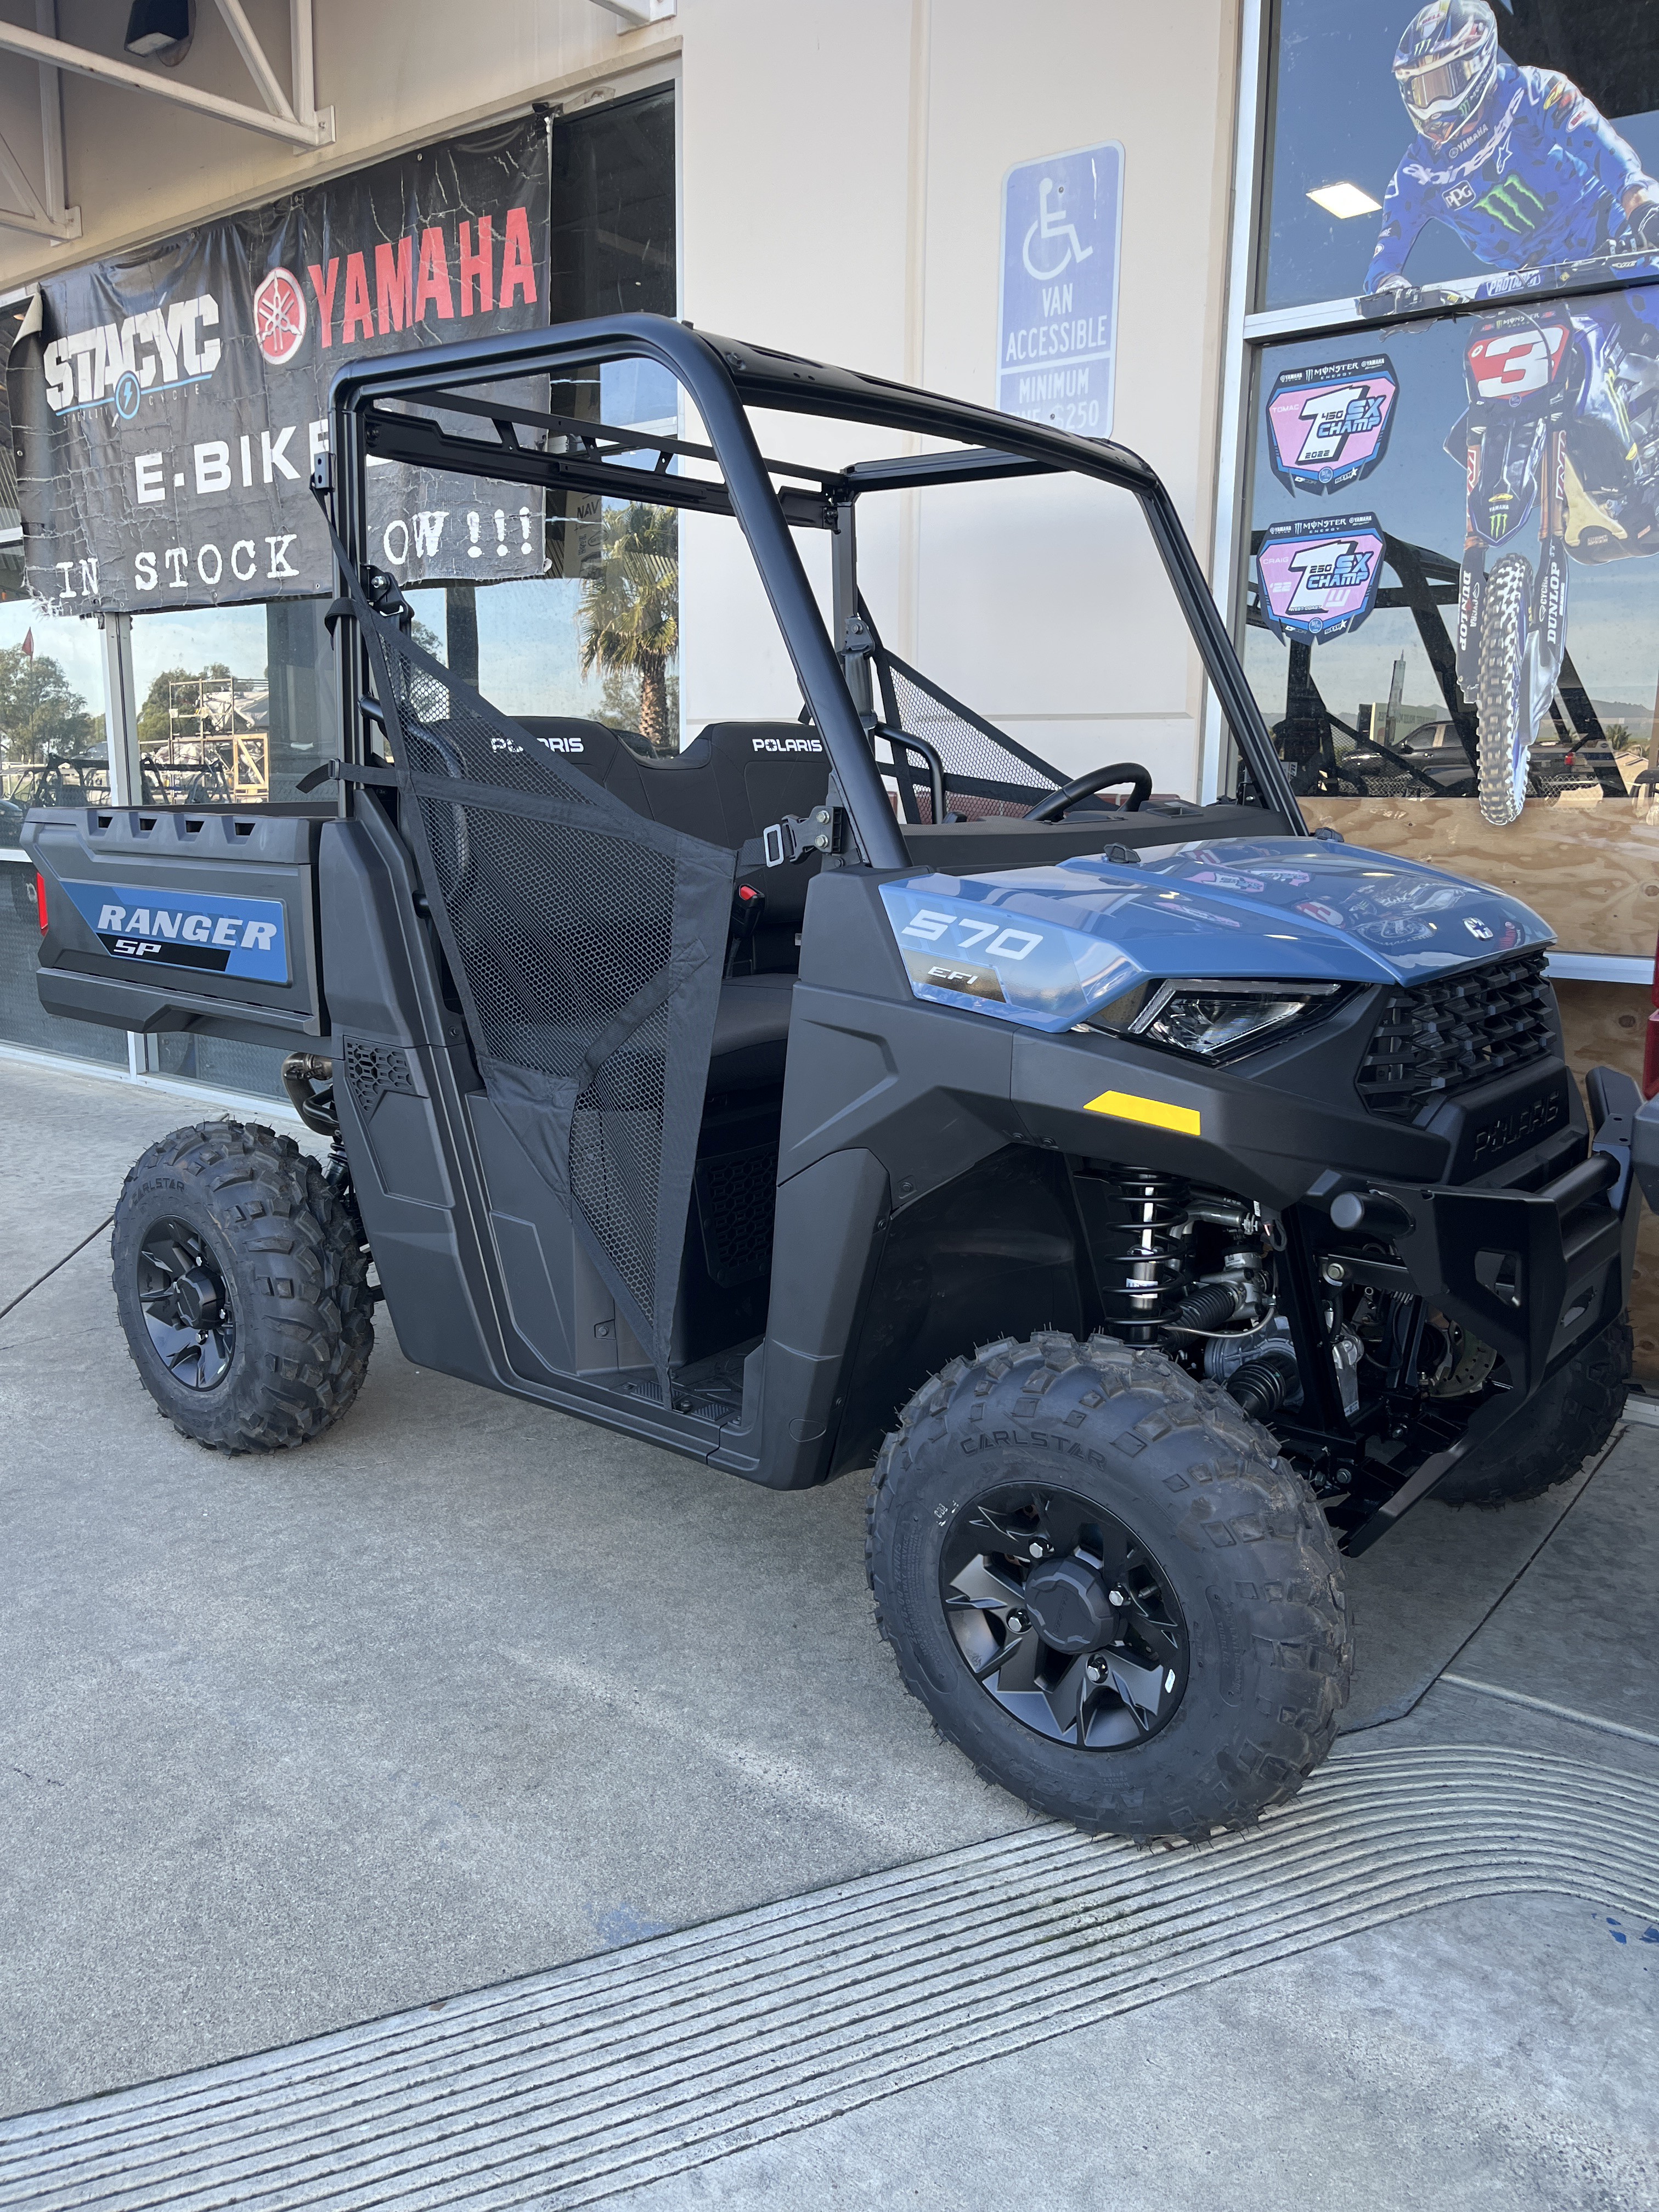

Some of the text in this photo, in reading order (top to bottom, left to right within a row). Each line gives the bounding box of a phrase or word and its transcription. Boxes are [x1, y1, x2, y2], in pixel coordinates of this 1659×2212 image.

[1458, 123, 1488, 151] YAMAHA
[1445, 185, 1472, 208] PPG
[308, 206, 537, 348] YAMAHA
[1042, 283, 1073, 318] VAN
[1503, 312, 1539, 325] MONSER
[1005, 315, 1108, 362] ACCESSIBLE
[43, 294, 222, 414] STACYC
[1478, 328, 1564, 398] 3
[1314, 362, 1358, 376] MONSTER
[149, 383, 199, 407] CYCLE
[1019, 367, 1089, 404] MINIMUM
[1272, 404, 1300, 413] TOMAC
[1321, 394, 1386, 420] 450 SX
[1317, 415, 1381, 438] CHAMP
[1305, 449, 1330, 459] 2022
[1303, 518, 1346, 531] MONSTER
[56, 556, 99, 599] IN
[134, 533, 300, 591] STOCK
[1309, 552, 1374, 575] 250 SX
[1306, 572, 1369, 590] CHAMP
[1540, 575, 1548, 605] CYCRA
[1459, 570, 1471, 651] DUNLOP
[1547, 561, 1560, 645] DUNLOP
[752, 738, 822, 753] POLARIS
[97, 904, 277, 951] RANGER
[901, 909, 1043, 961] 570
[112, 939, 162, 956] SP
[927, 966, 979, 985] EFI
[1472, 1089, 1559, 1162] POLARIS
[960, 1429, 1107, 1471] CARLSTAR
